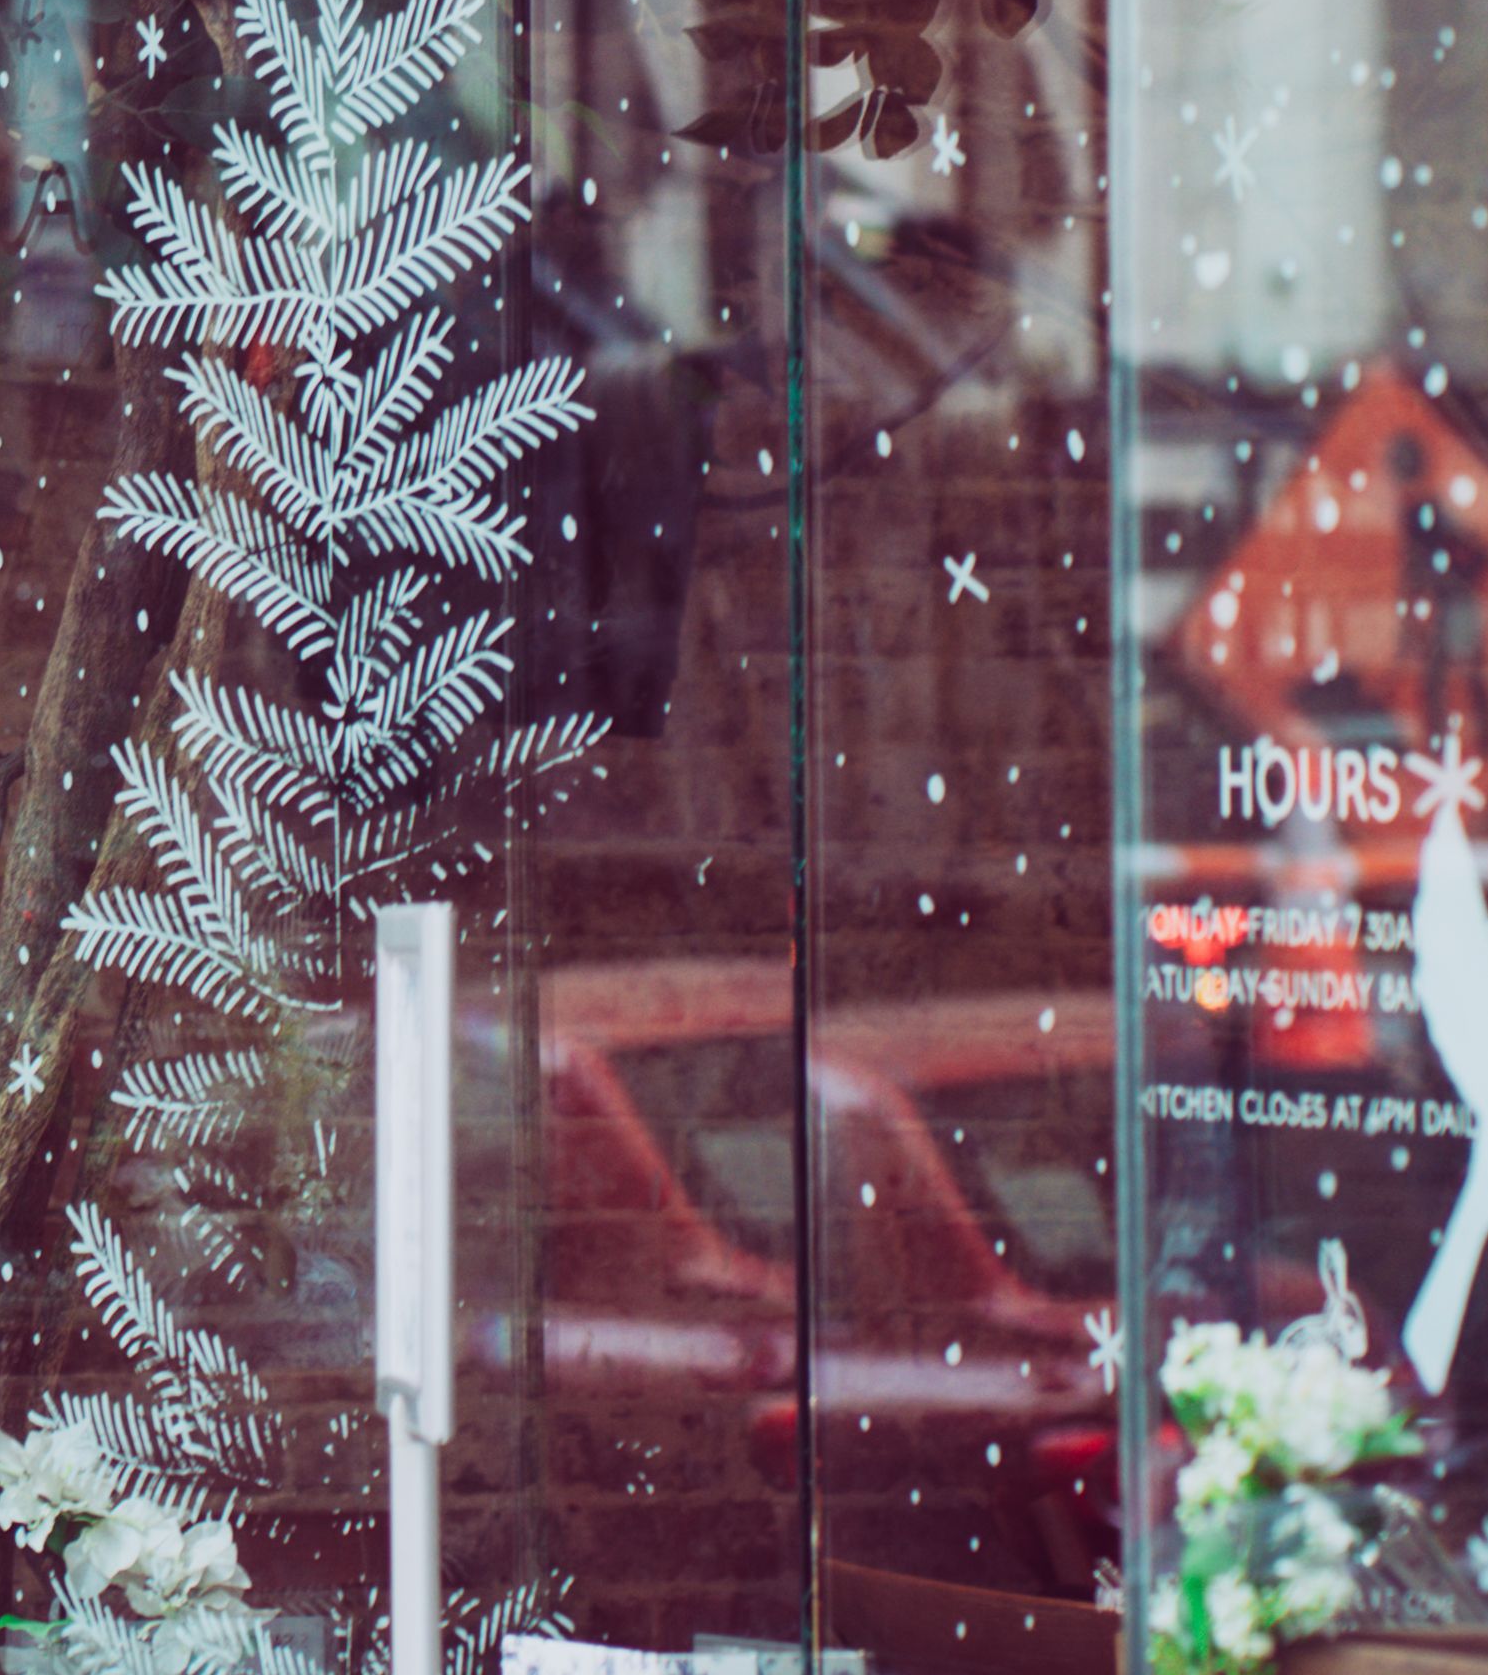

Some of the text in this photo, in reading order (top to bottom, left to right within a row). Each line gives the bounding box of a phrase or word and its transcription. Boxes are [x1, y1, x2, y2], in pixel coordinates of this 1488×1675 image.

[1219, 747, 1401, 823] HOURS
[1141, 904, 1340, 948] ONDAY-FRIDAY
[1144, 964, 1373, 1010] ATURDAY-SUNDAY
[1331, 1094, 1362, 1131] AT
[1423, 1100, 1479, 1139] DAIL
